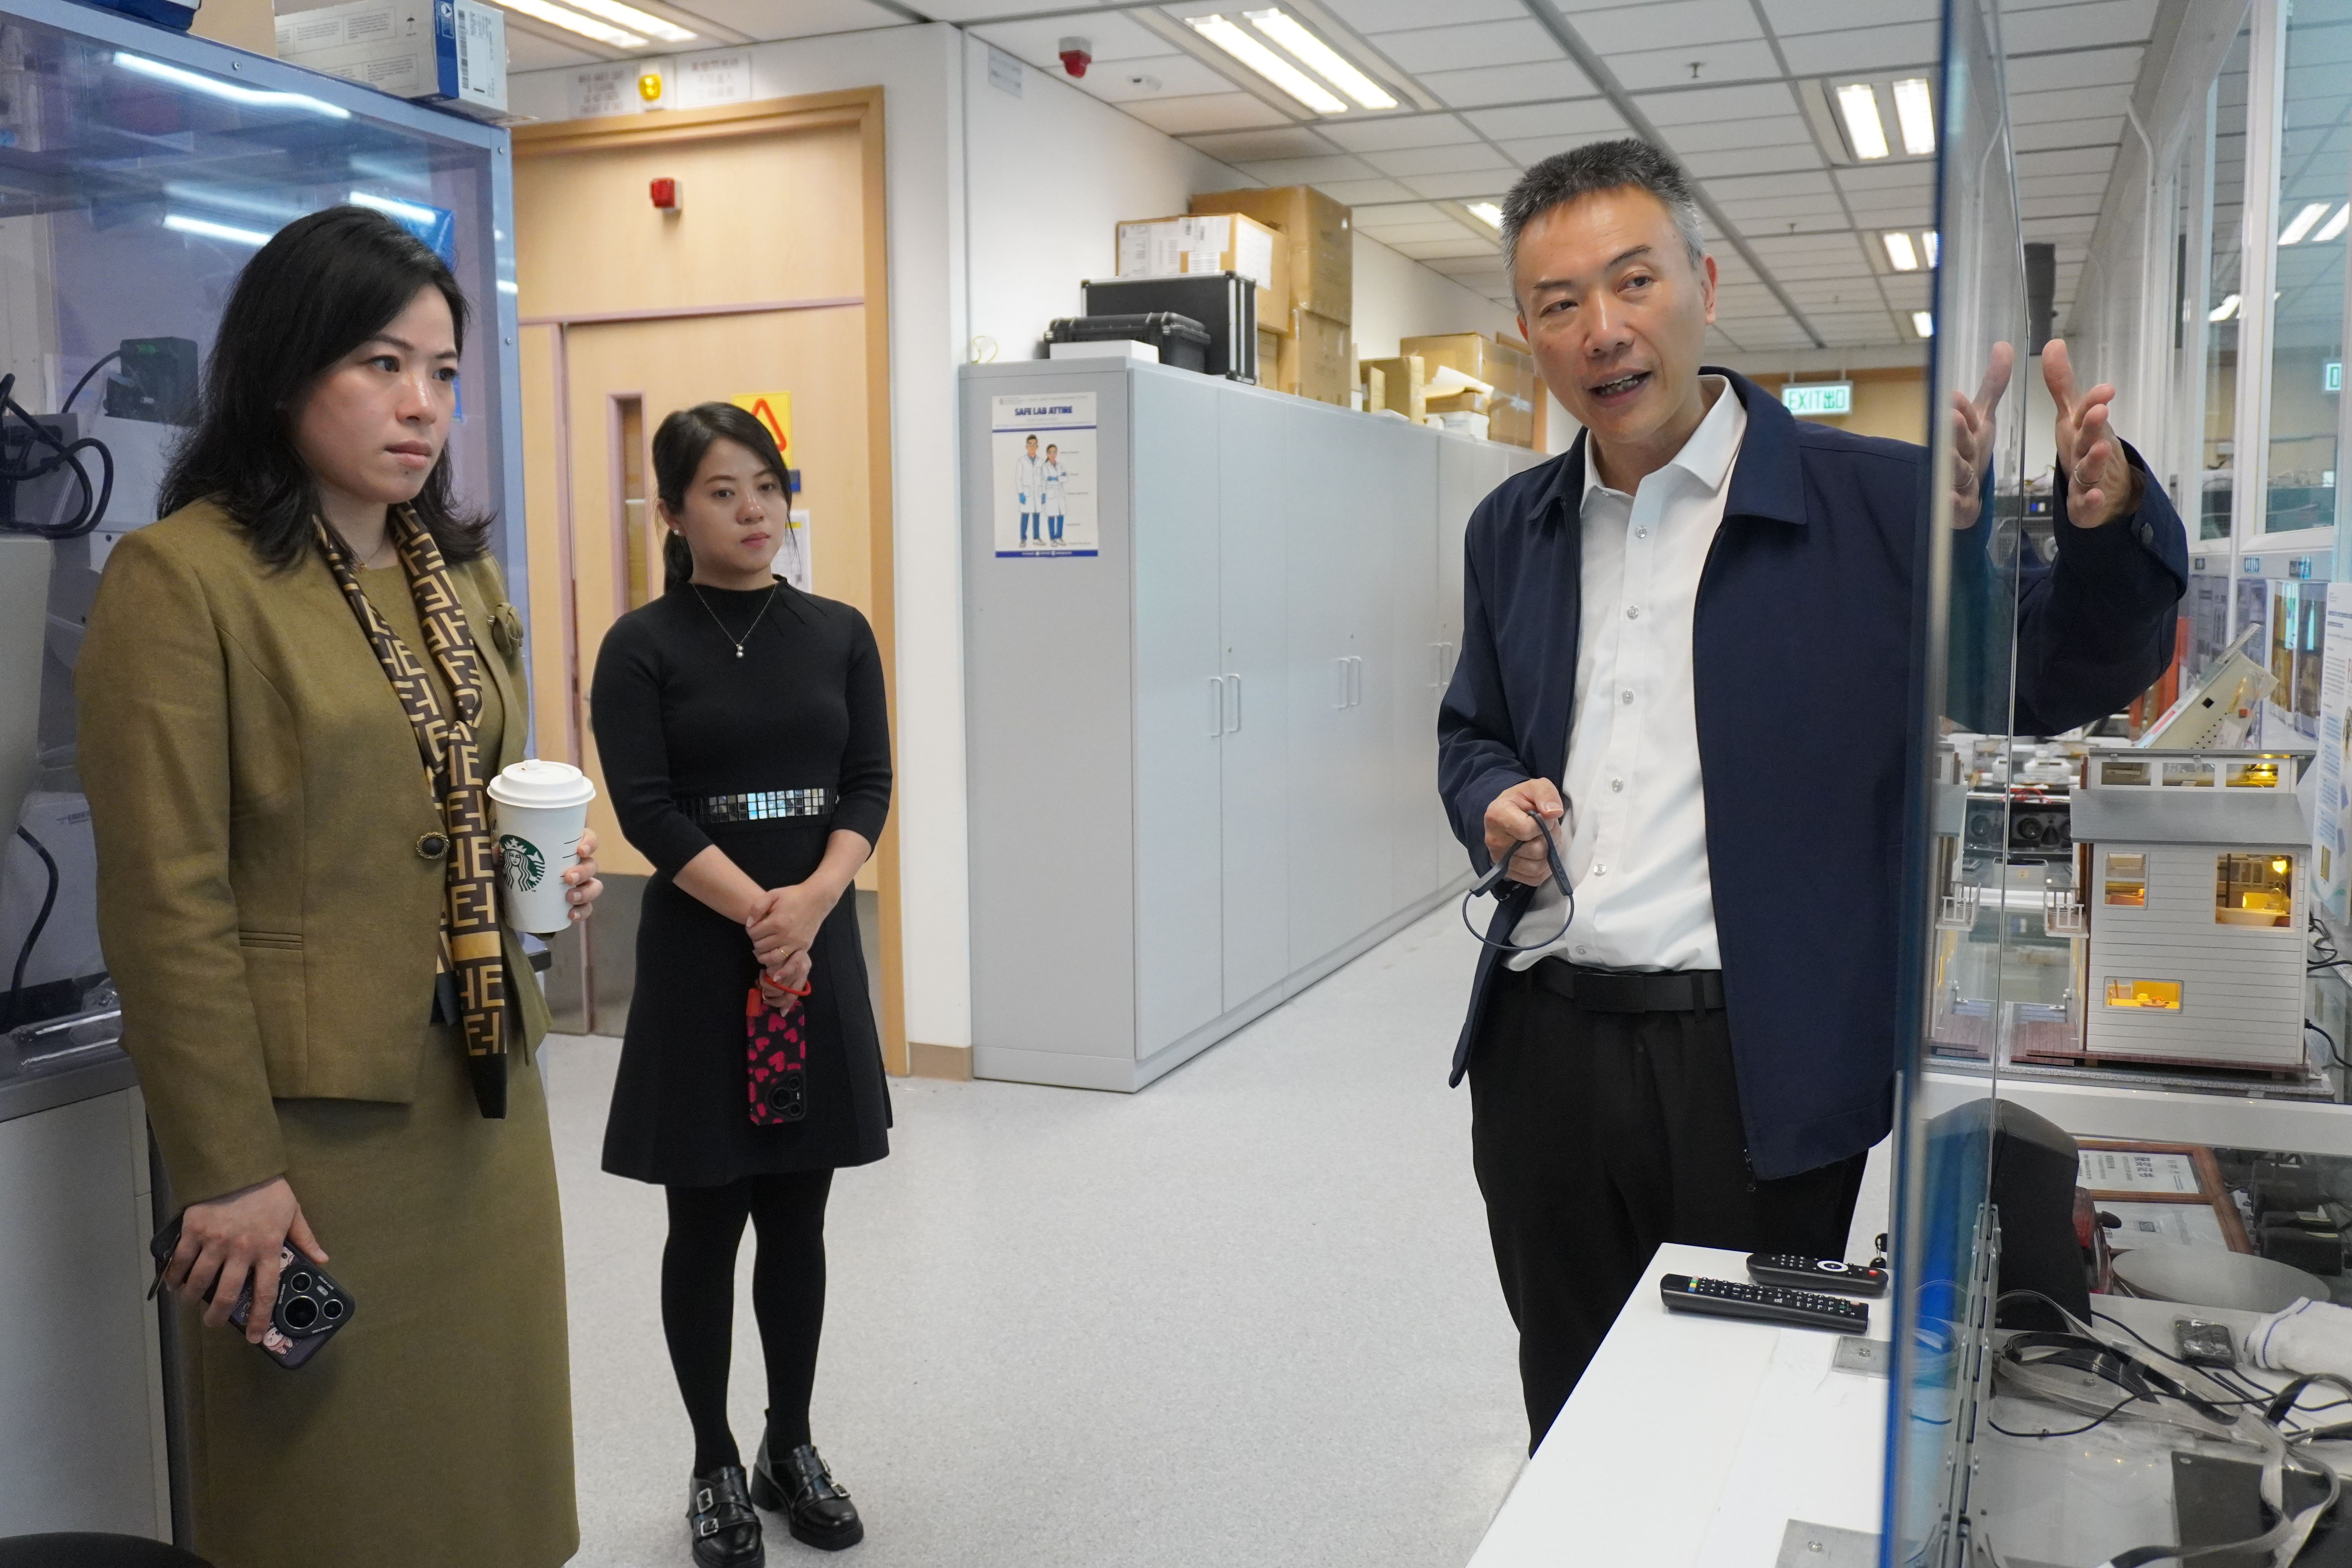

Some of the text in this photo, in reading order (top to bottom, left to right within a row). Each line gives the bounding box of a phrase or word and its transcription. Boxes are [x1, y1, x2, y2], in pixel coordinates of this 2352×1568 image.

[1789, 389, 1845, 410] EXIT 出口
[1014, 407, 1031, 416] SAFE
[1049, 406, 1073, 414] ATTIRE
[318, 1276, 328, 1285] DREAM
